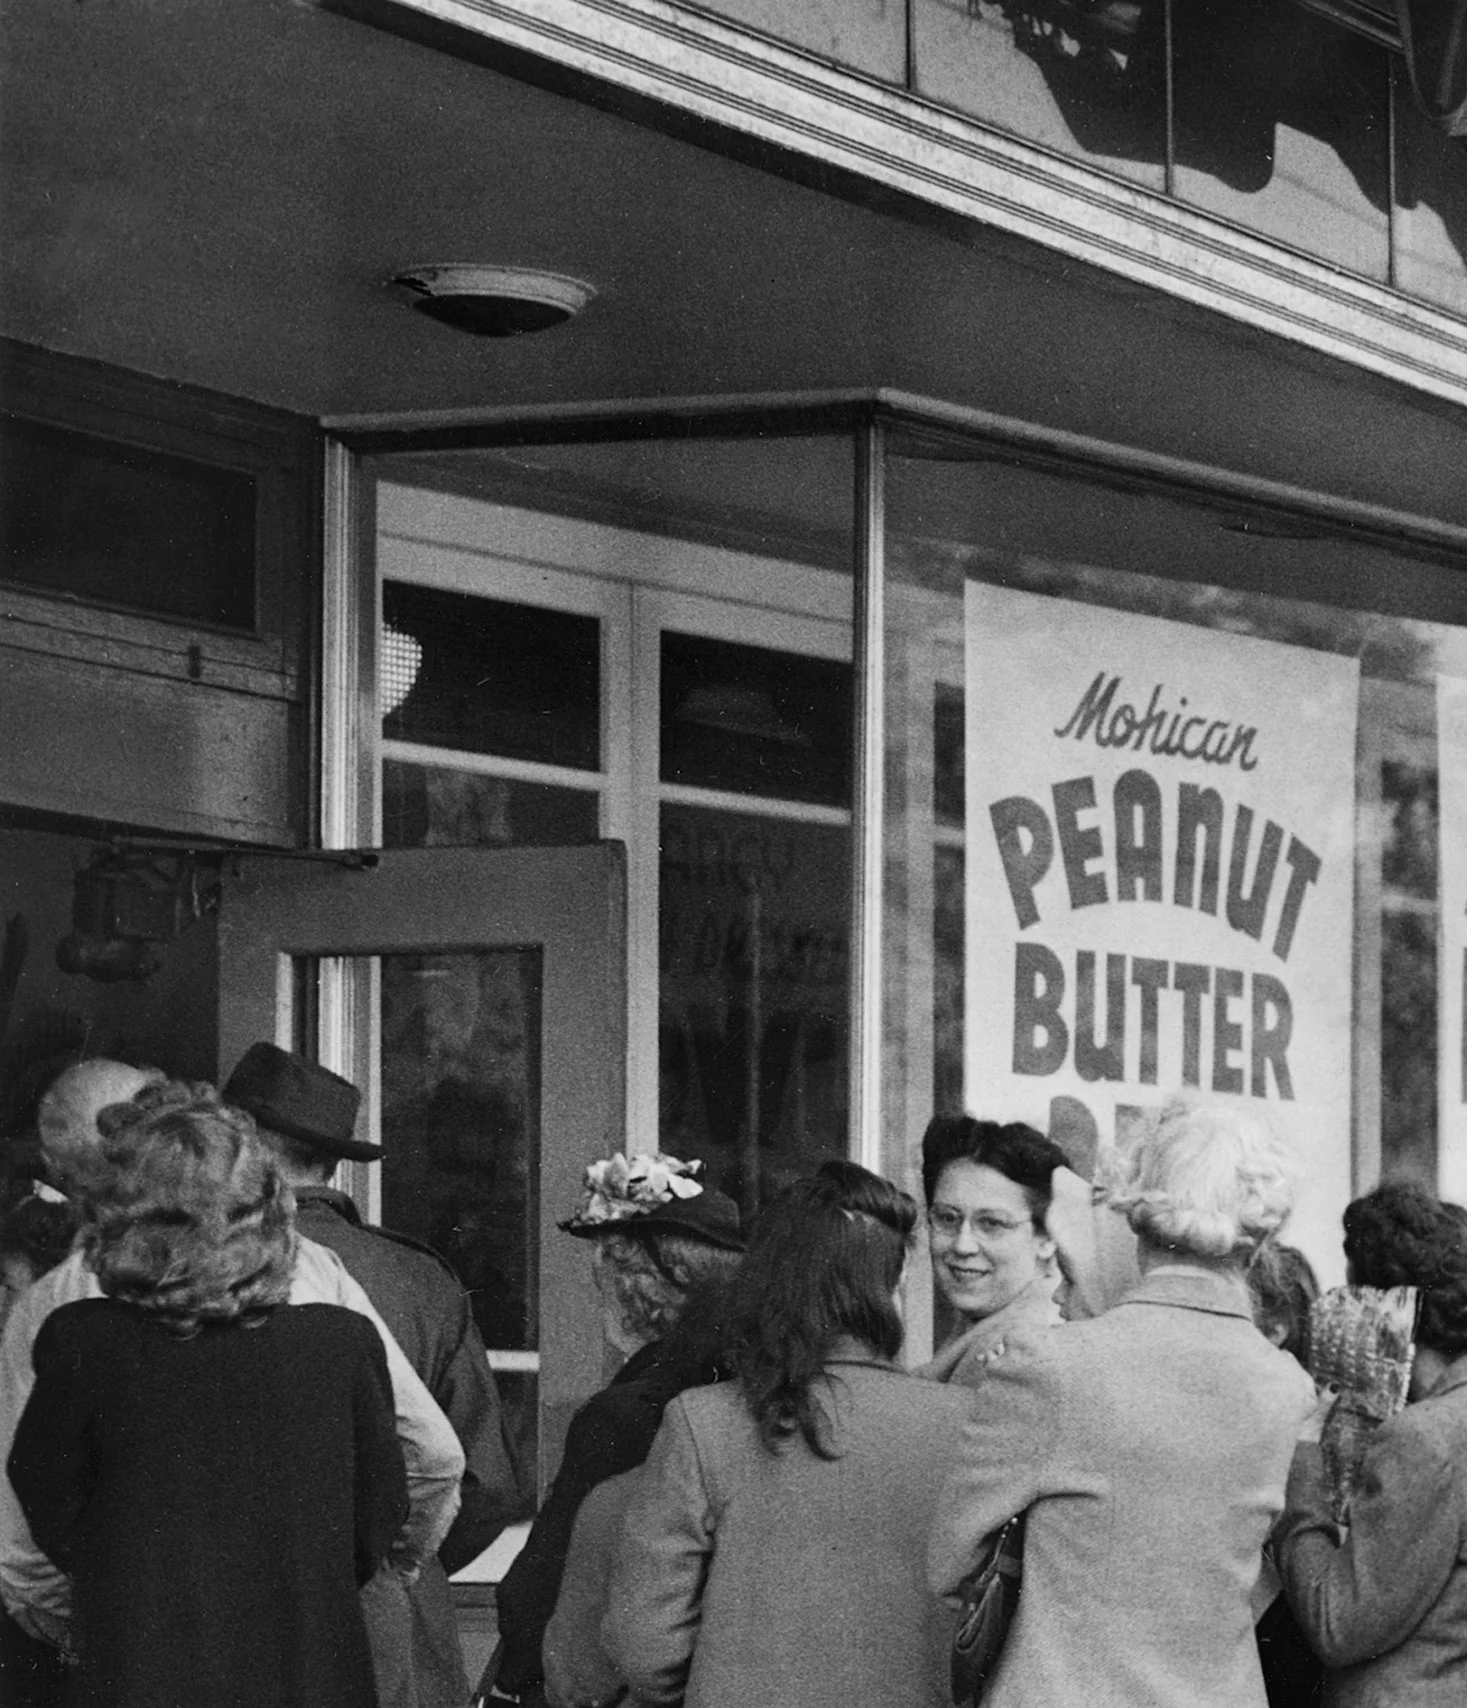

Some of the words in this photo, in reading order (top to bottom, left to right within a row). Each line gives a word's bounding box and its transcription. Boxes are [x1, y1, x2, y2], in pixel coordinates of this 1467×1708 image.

[1054, 670, 1259, 771] Mohican
[988, 769, 1322, 963] PEANUT
[1011, 942, 1296, 1103] BUTTER
